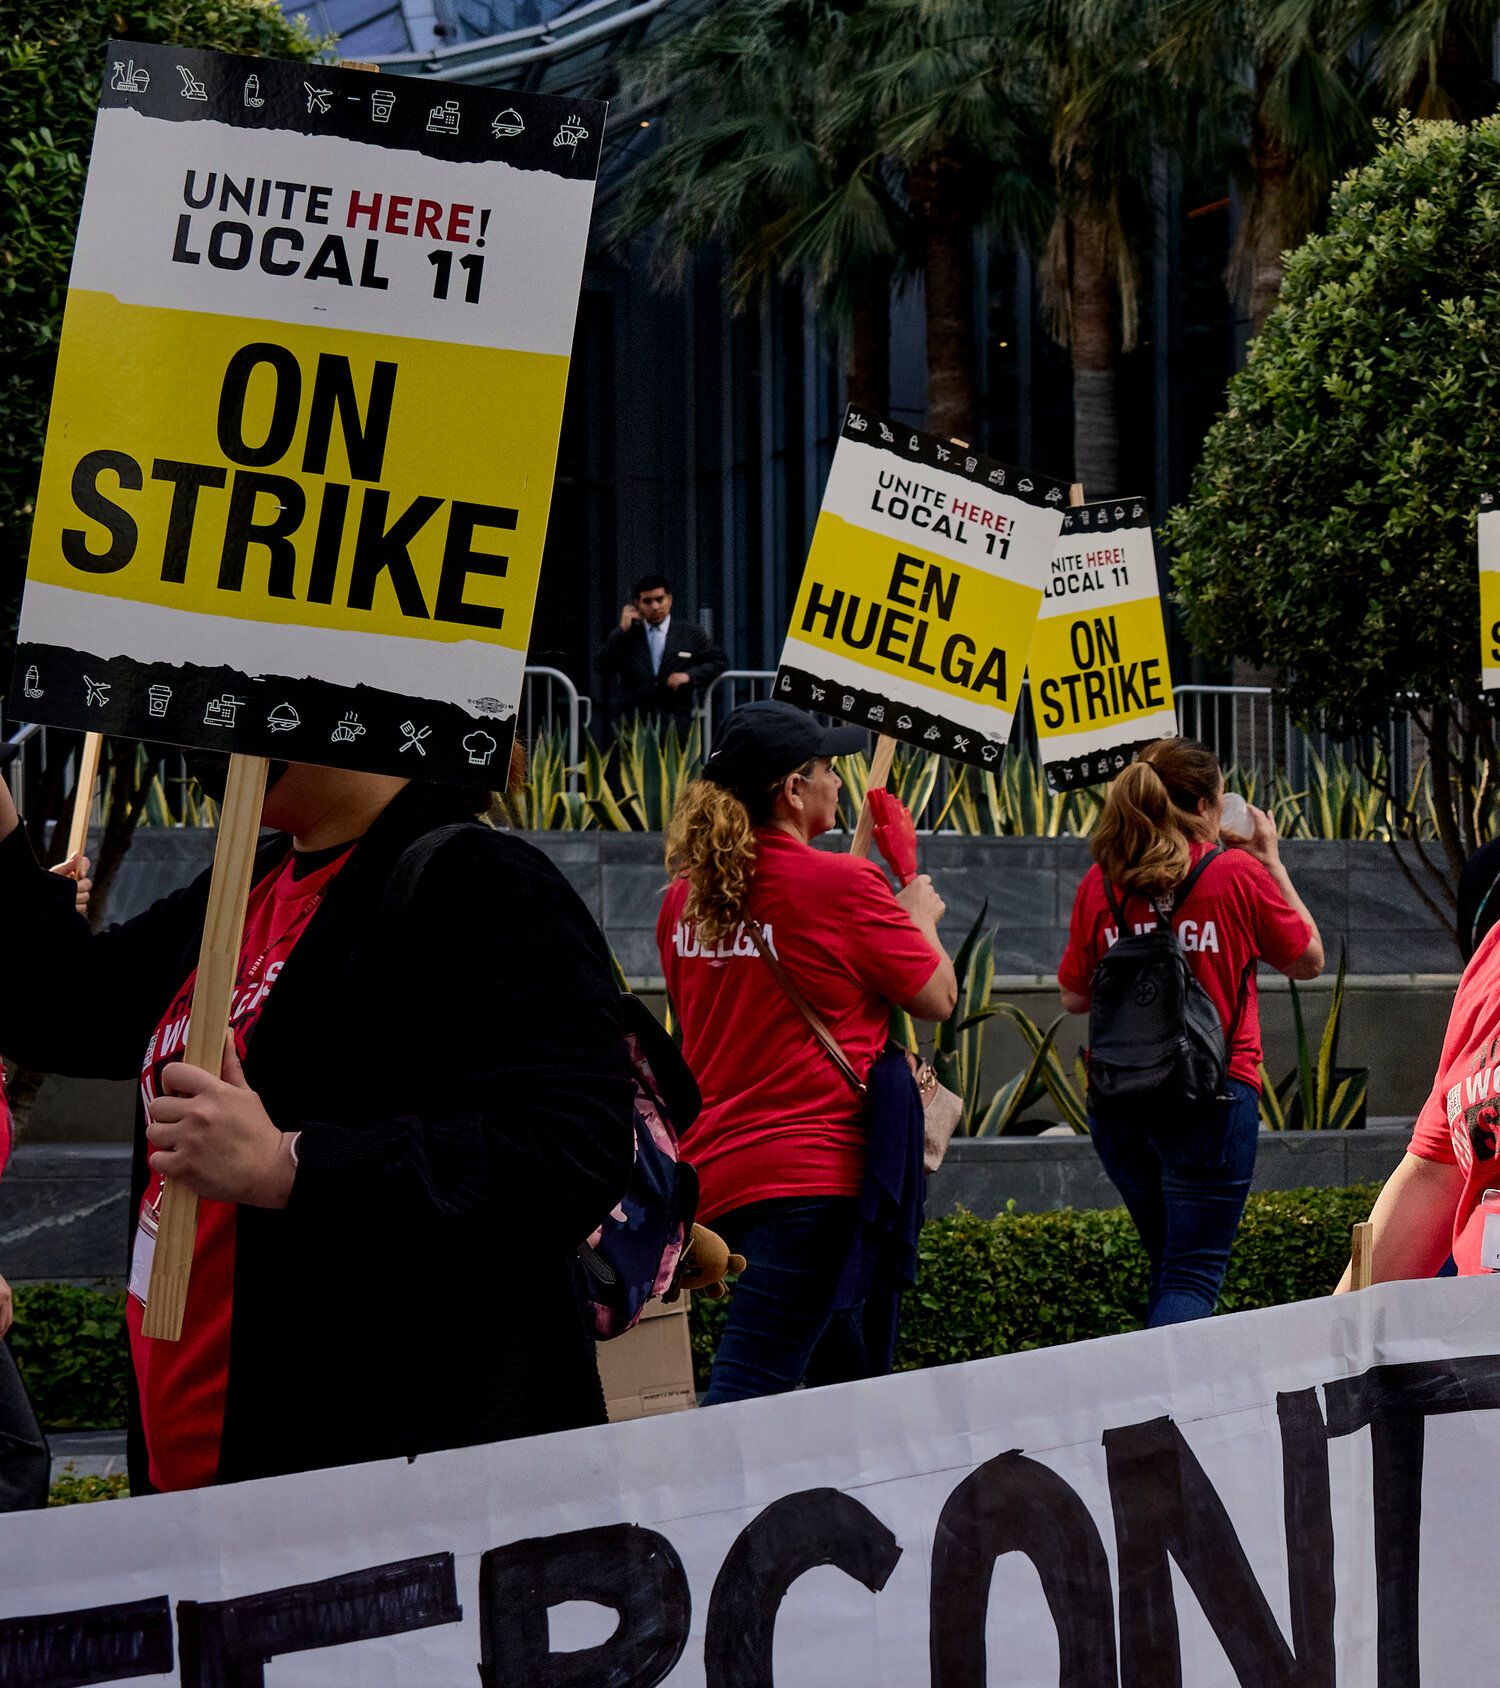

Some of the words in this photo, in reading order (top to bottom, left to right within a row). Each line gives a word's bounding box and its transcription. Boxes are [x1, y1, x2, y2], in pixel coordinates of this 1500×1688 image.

[182, 169, 334, 227] UNITE
[345, 190, 493, 247] HERE!
[171, 213, 391, 292] LOCAL
[427, 250, 485, 305] 11
[216, 341, 399, 484] ON
[60, 448, 520, 630] STRIKE
[871, 489, 968, 545] LOCAL
[985, 533, 1011, 560] 11
[878, 470, 946, 510] UNITE
[951, 498, 1015, 537] HERE!
[887, 552, 961, 622] EN
[1044, 570, 1105, 598] LOCAL
[1112, 566, 1129, 587] 11
[1051, 554, 1083, 574] NITE
[1086, 548, 1126, 568] HERE!
[800, 582, 1008, 702] HUELGA
[1070, 616, 1121, 671] ON
[1040, 658, 1165, 729] STRIKE
